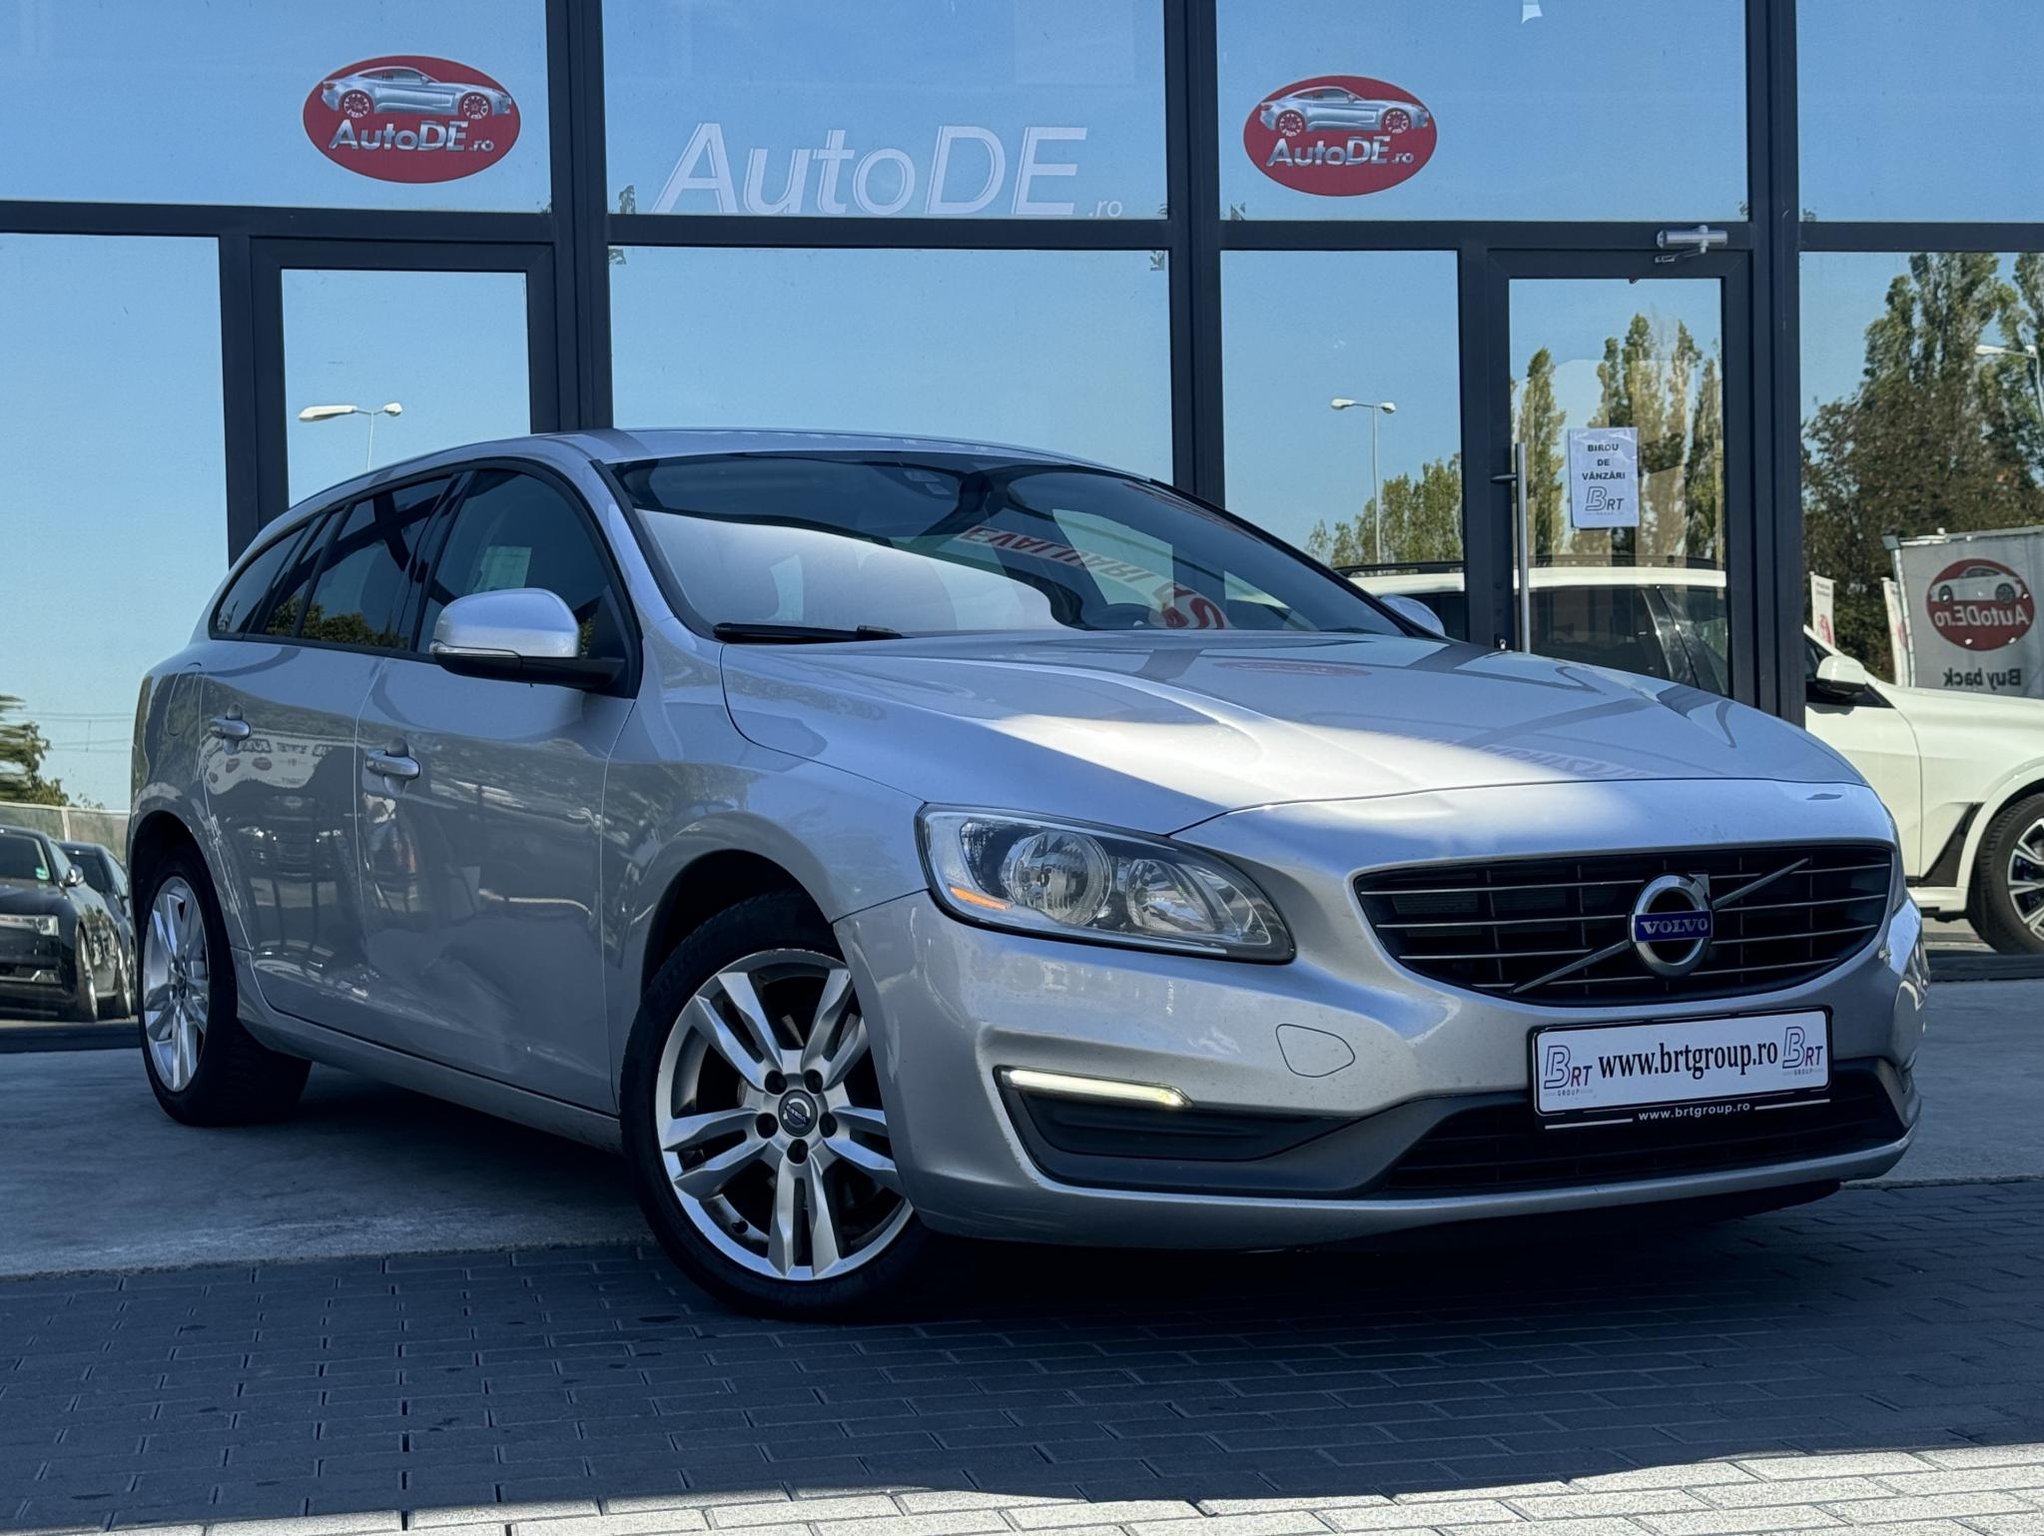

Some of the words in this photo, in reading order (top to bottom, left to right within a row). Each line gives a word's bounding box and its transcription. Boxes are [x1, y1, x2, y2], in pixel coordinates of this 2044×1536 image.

[1587, 443, 1619, 452] BIROU
[1597, 458, 1610, 466] DE
[1641, 918, 1708, 935] VOLVO
[1543, 1044, 1593, 1090] BRT
[1598, 1042, 1778, 1081] www.brtgroup.ro
[1782, 1026, 1824, 1069] BRT
[1638, 1102, 1751, 1122] www.brtgroup.ro
